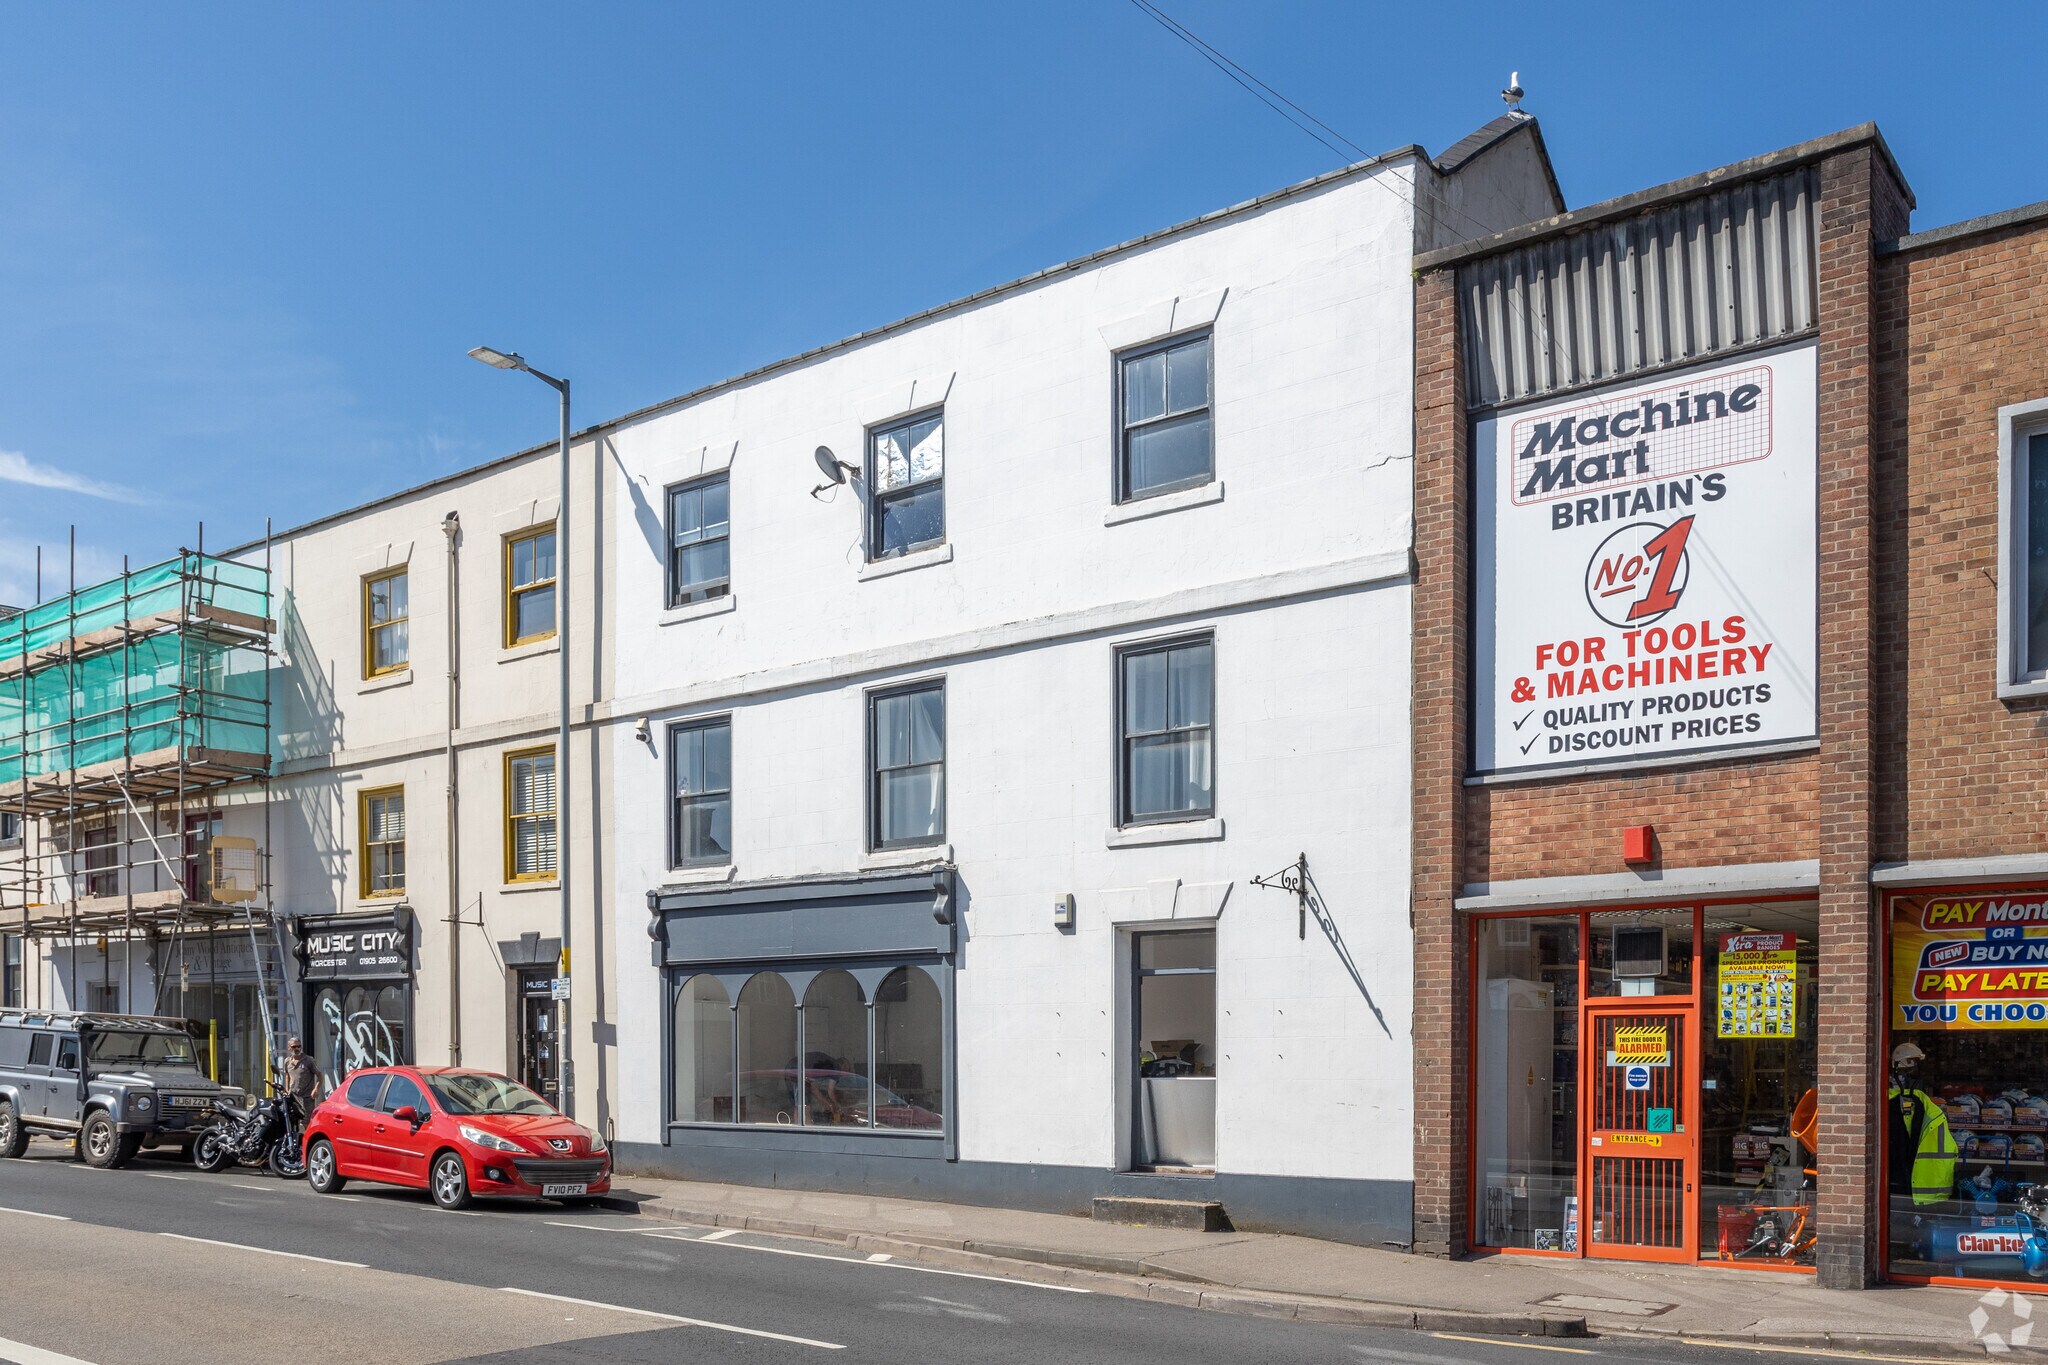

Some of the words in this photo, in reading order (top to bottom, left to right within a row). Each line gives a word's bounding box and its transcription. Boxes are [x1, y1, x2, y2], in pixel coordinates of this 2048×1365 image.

[1519, 383, 1762, 460] Machine
[1519, 439, 1650, 497] Mart
[1536, 636, 1606, 671] FOR
[1622, 615, 1746, 658] TOOLS
[1510, 676, 1536, 703] &
[1547, 643, 1773, 699] MACHINERY
[1543, 700, 1634, 731] QUALITY
[1642, 683, 1772, 717] PRODUCTS
[1549, 724, 1663, 754] DISCOUNT
[1671, 713, 1762, 742] PRICES
[1929, 901, 1984, 924] PAY
[1992, 927, 2016, 939] OR
[221, 942, 254, 958] Antiques
[307, 934, 354, 954] MUSIC
[361, 931, 398, 951] CITY
[1726, 935, 1754, 952] Xtra
[1732, 952, 1760, 960] 15,000
[1935, 946, 1963, 962] NEW
[1972, 945, 2024, 962] BUY
[311, 958, 347, 968] WORCESTER
[526, 980, 548, 989] MUSIC
[1921, 973, 1978, 992] PAY
[1901, 1003, 1958, 1023] YOU
[1967, 1003, 2048, 1022] CHOO
[1620, 1043, 1662, 1054] ALARMED
[1611, 1135, 1648, 1143] ENTRANCE
[1734, 1142, 1748, 1150] BIG
[547, 1185, 566, 1194] FV10
[566, 1185, 583, 1194] PFZ
[1959, 1234, 2025, 1252] Clarke
